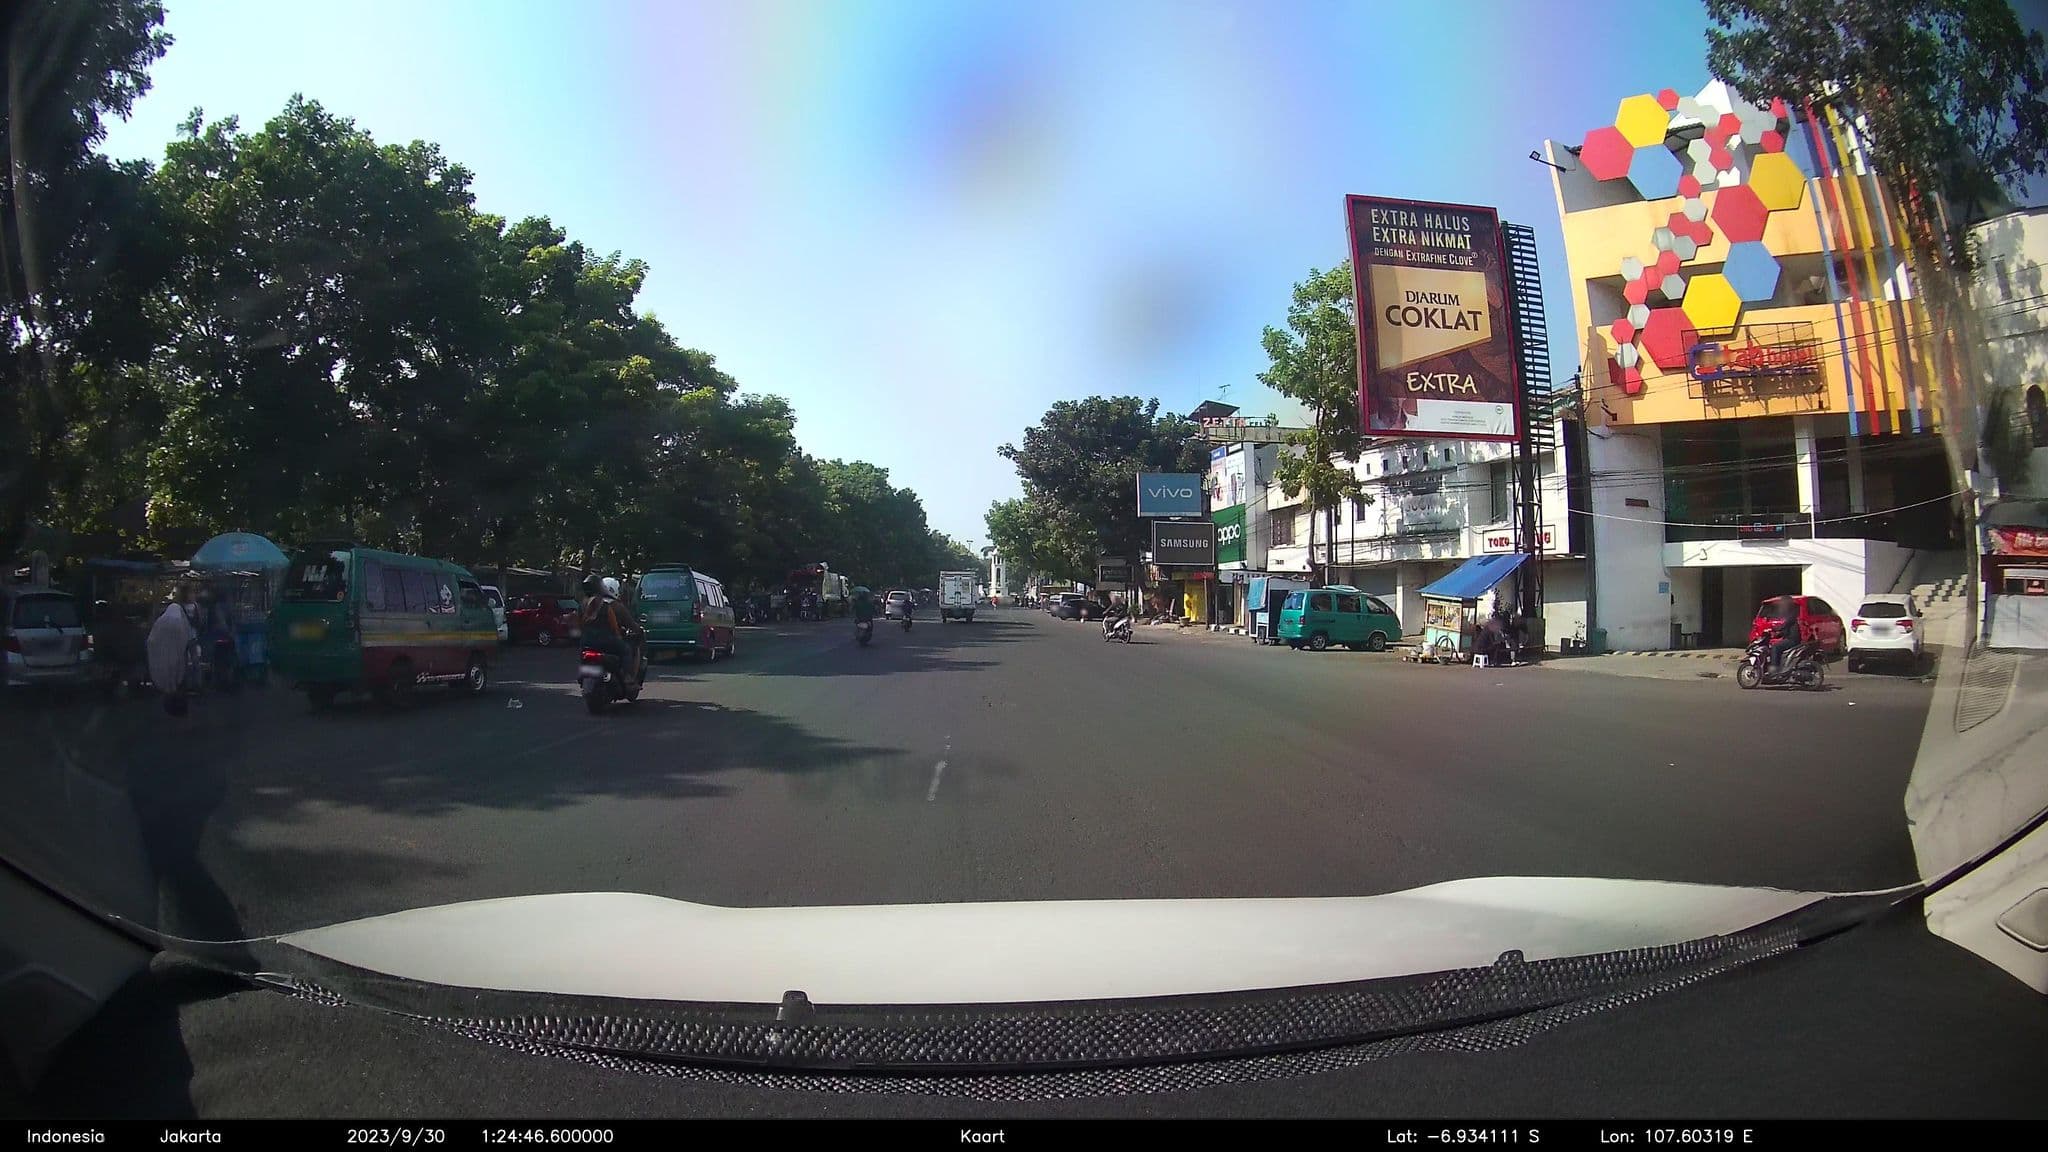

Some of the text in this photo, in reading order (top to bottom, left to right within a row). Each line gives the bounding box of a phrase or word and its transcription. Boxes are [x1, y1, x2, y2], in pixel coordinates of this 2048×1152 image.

[1371, 208, 1470, 231] EXTRA HALUS
[1372, 226, 1472, 250] EXTRA NIKMAT
[1374, 247, 1404, 258] DENGAN
[1405, 290, 1460, 306] DJARUM
[1385, 304, 1482, 331] COKLAT
[1406, 371, 1478, 394] EXTRA
[1148, 485, 1193, 498] vivo
[1160, 538, 1209, 548] SAMSUNG
[1218, 523, 1241, 546] oppo
[1488, 536, 1510, 548] TOKO
